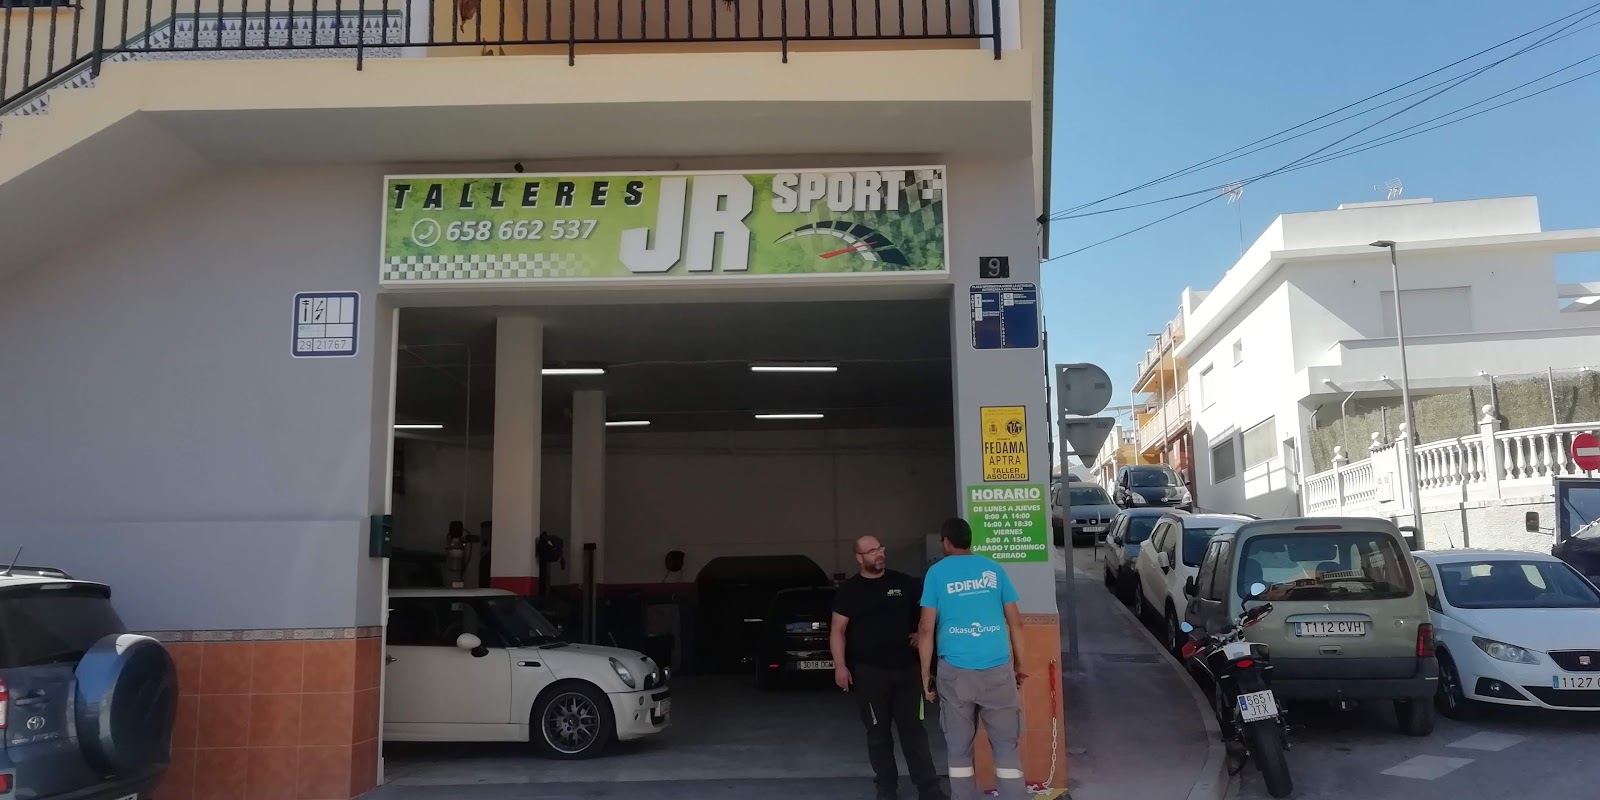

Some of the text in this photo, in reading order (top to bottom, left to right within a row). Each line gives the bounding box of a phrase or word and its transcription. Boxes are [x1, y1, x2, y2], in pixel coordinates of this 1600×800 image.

[394, 170, 906, 273] TALLERES JR SPORT
[446, 218, 598, 241] 658 662 537
[988, 258, 1000, 277] 9
[300, 340, 346, 350] 29 21767
[985, 442, 1024, 454] FEDAMA
[989, 455, 1021, 465] APTRA
[972, 488, 1040, 500] HORARIO
[1305, 622, 1361, 633] T112 CVH
[1563, 678, 1592, 687] 1127
[1247, 692, 1271, 705] 5651
[1251, 704, 1269, 716] JTX
